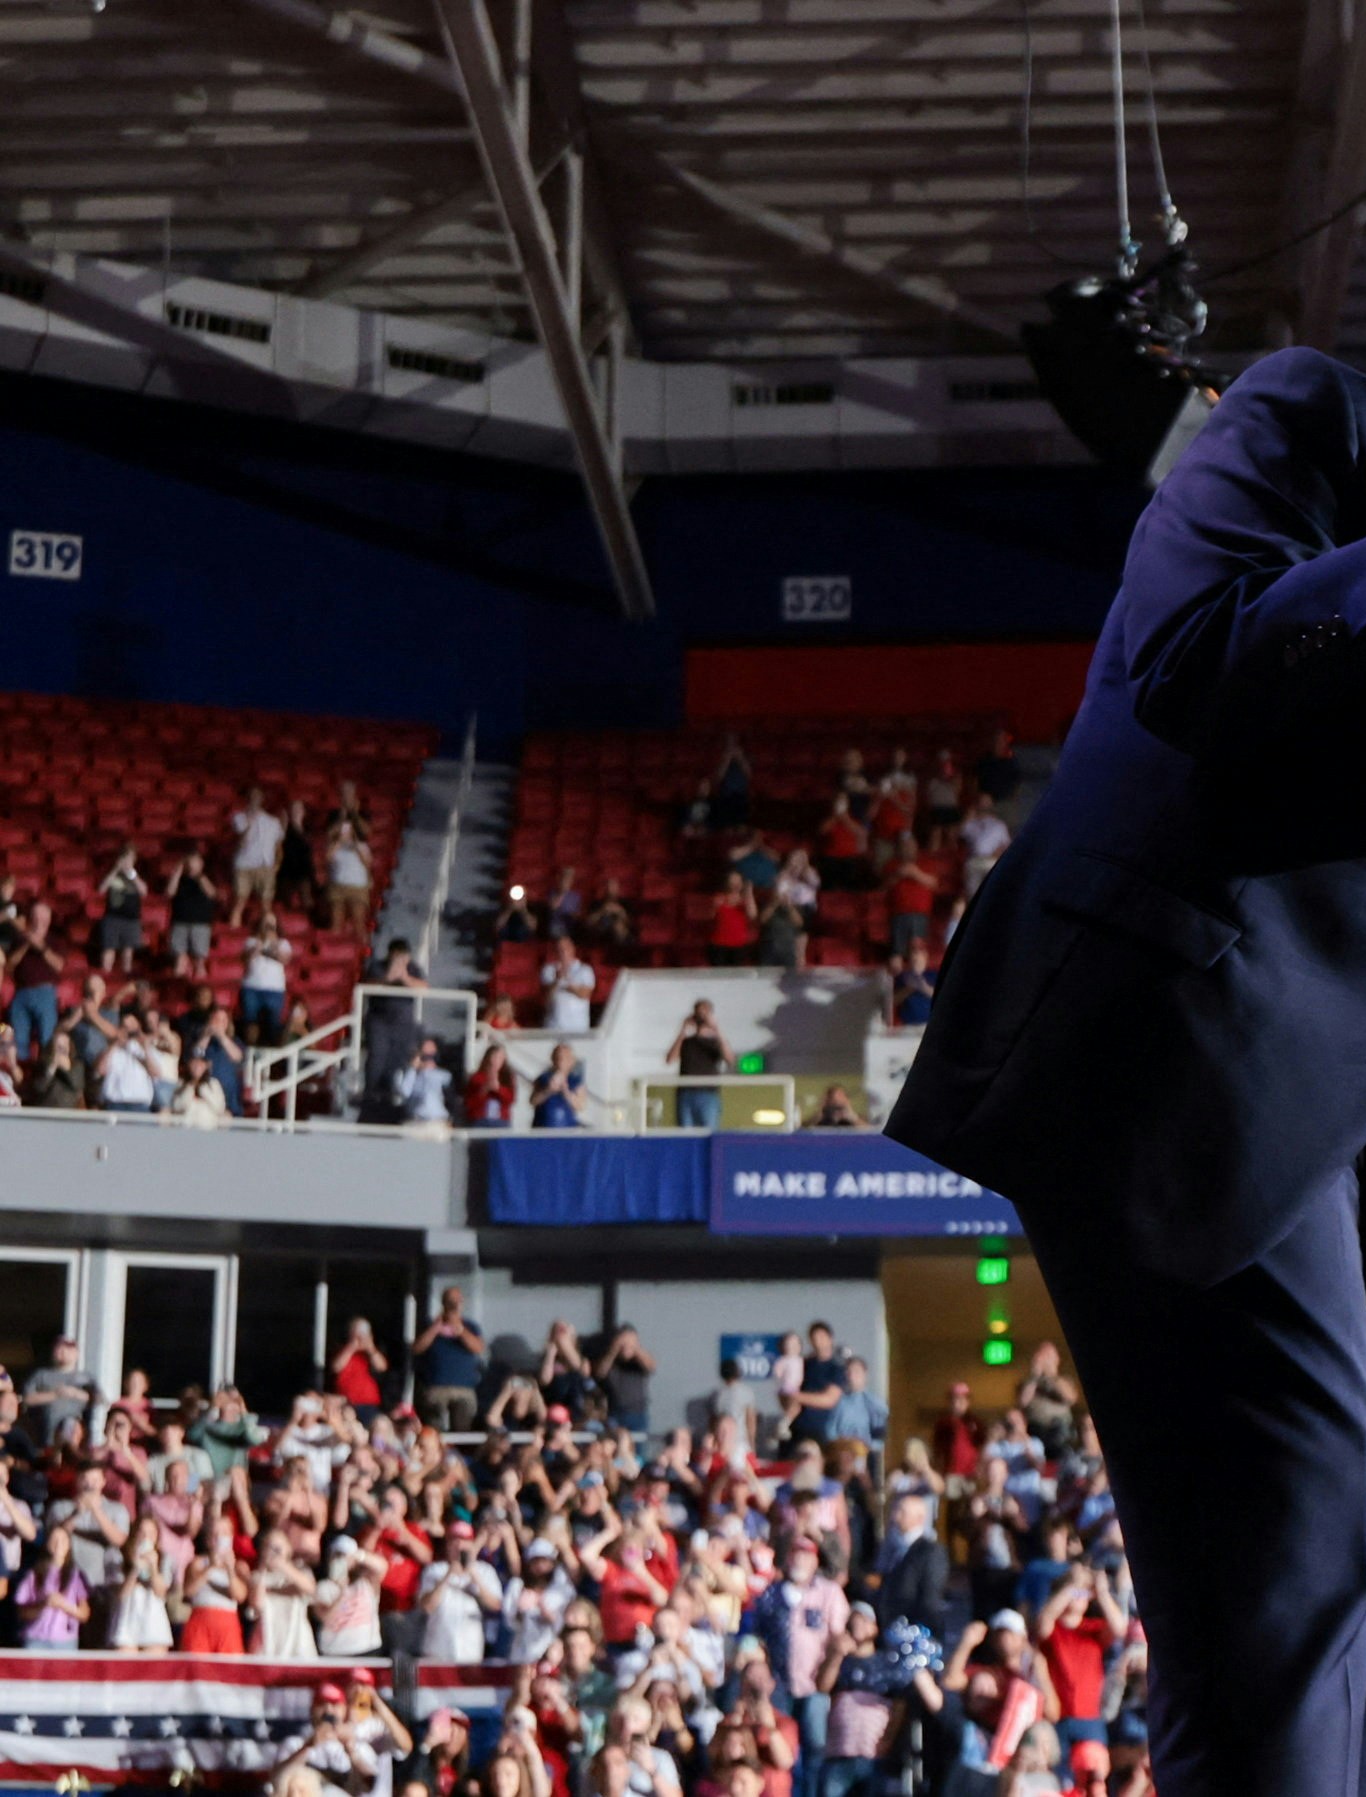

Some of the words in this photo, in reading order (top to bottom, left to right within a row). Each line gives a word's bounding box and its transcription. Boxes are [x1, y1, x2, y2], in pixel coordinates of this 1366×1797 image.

[15, 538, 79, 571] 319
[789, 584, 850, 613] 320
[733, 1171, 827, 1198] MAKE
[834, 1171, 983, 1198] AMERICA
